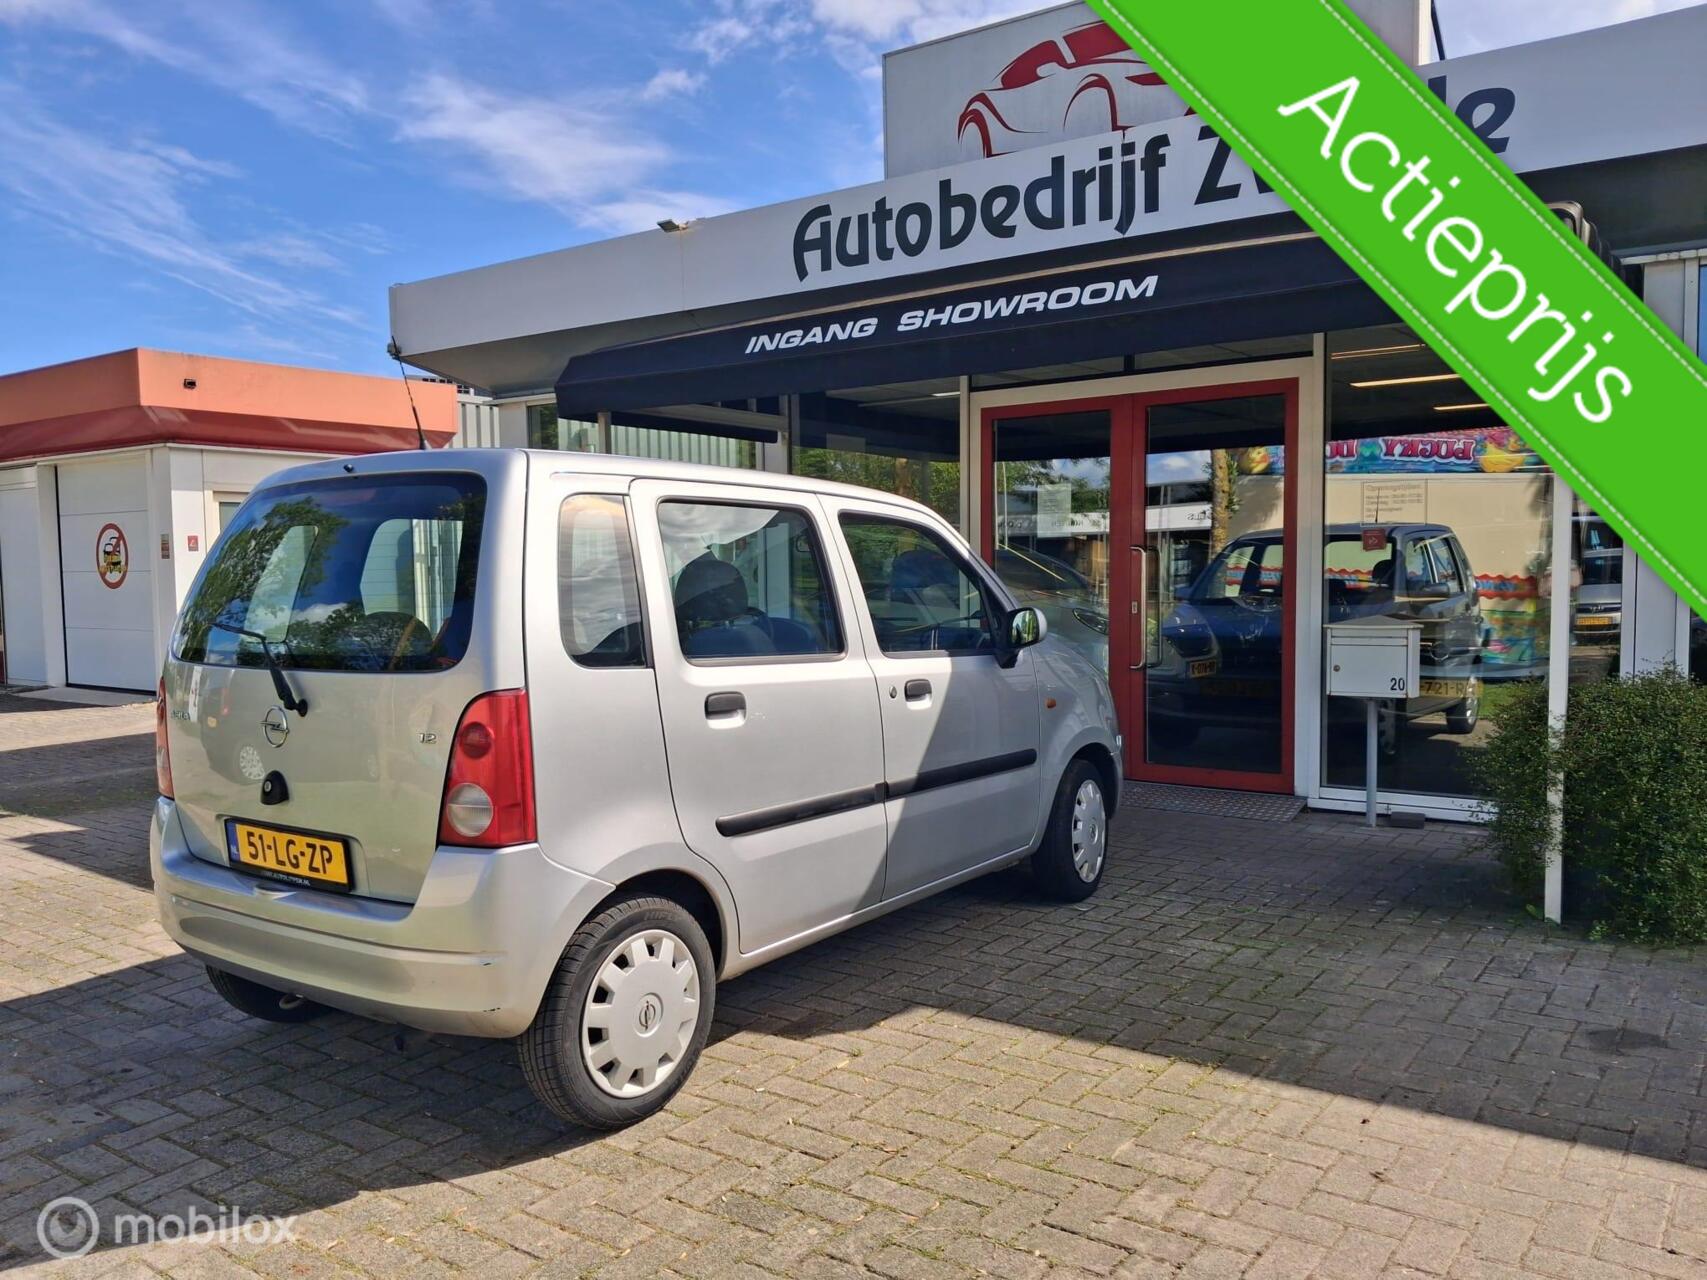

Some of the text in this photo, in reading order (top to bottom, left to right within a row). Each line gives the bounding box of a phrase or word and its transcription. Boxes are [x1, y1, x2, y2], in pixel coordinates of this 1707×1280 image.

[793, 133, 1171, 282] Autobedrijf
[744, 274, 1159, 355] INGANG SHOWROOM
[1390, 677, 1406, 691] 20
[246, 830, 333, 875] 51-LG-ZP
